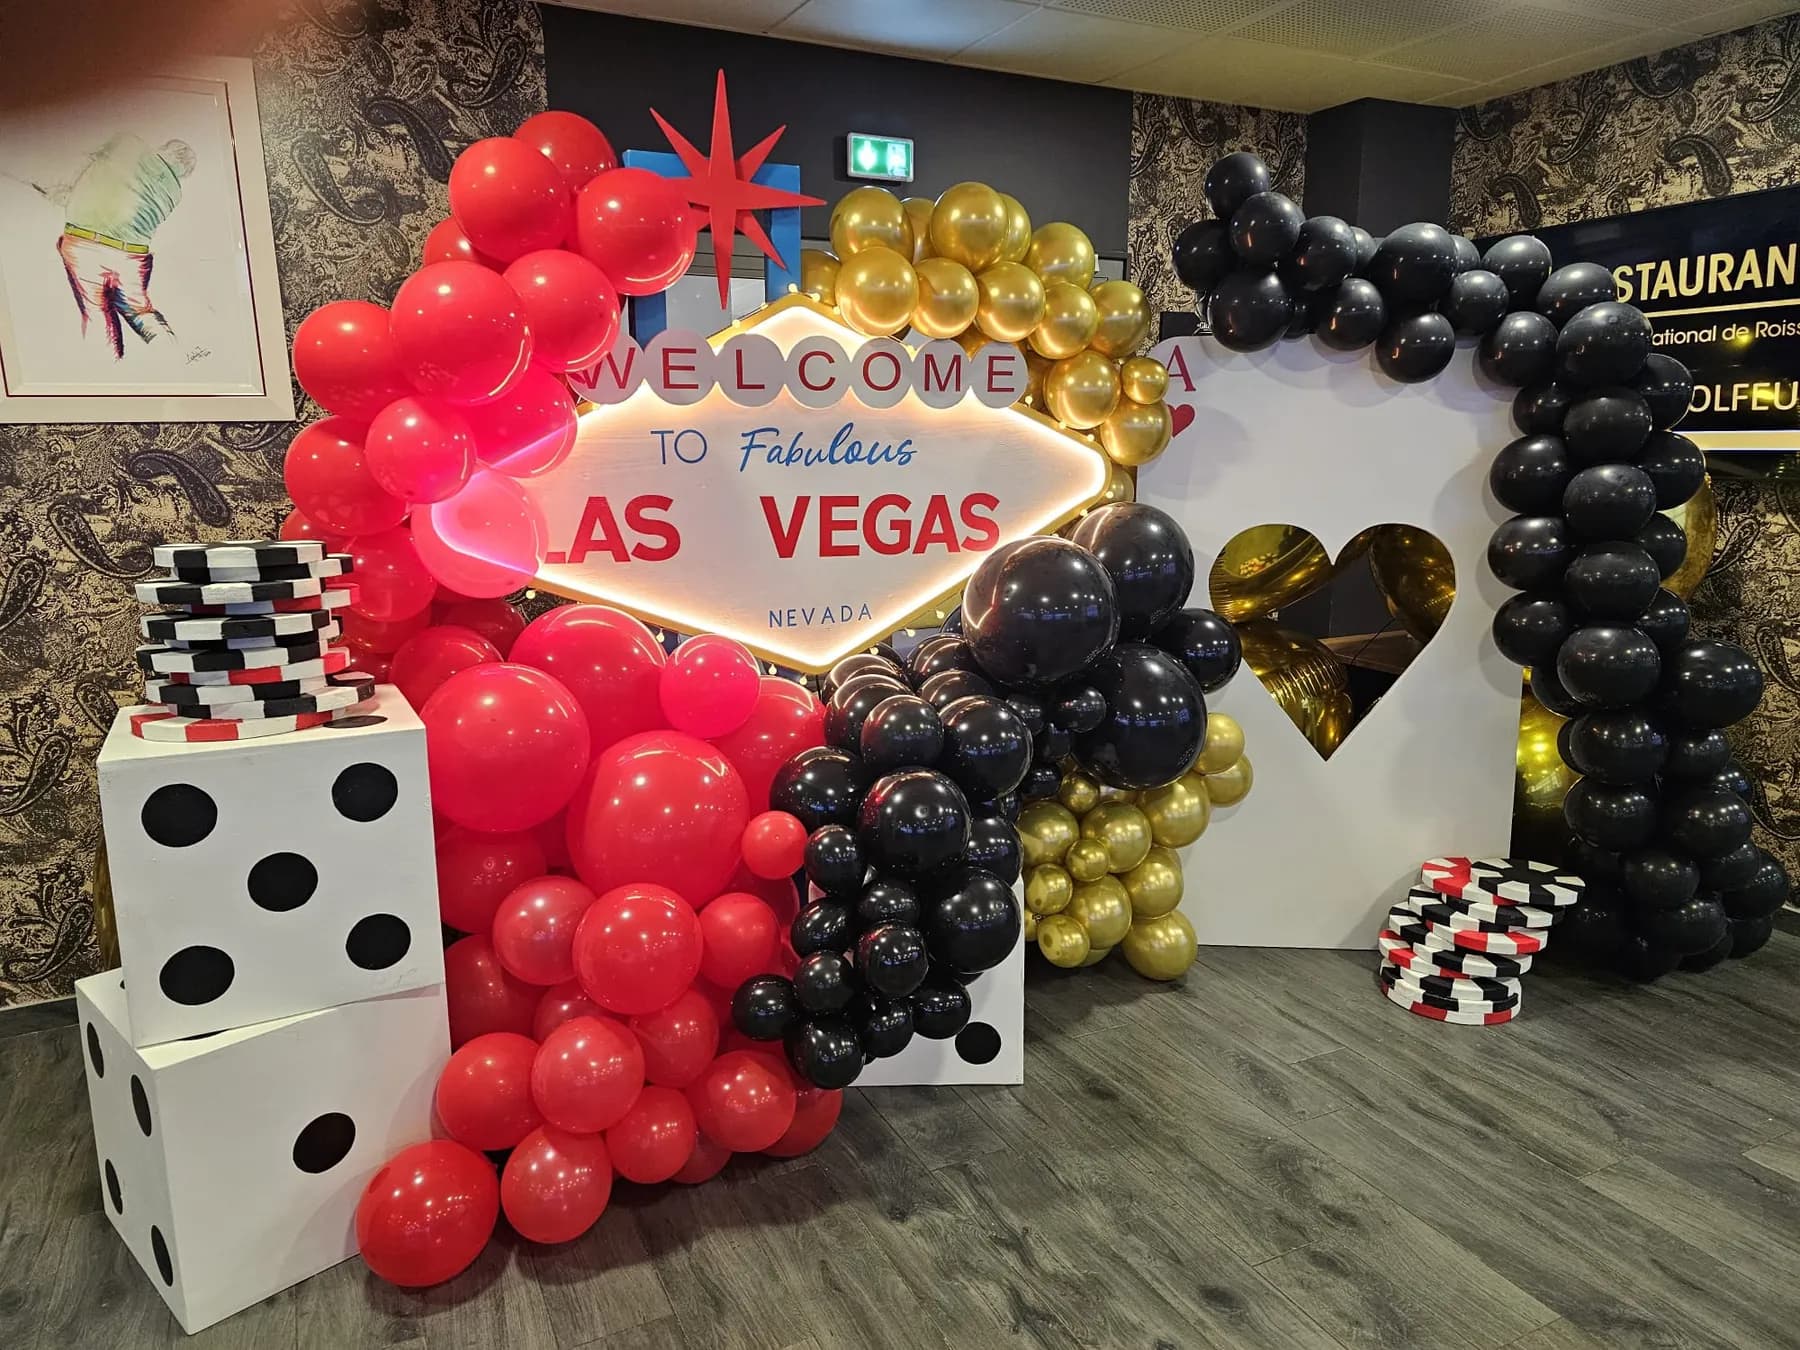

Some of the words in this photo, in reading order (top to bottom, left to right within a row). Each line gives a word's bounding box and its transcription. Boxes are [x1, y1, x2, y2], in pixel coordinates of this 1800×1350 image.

[1722, 323, 1750, 341] de
[580, 347, 1016, 392] WELCOME
[1167, 345, 1196, 392] A
[650, 429, 708, 465] TO
[739, 422, 918, 472] Fabulous
[544, 494, 681, 564] AS
[759, 492, 1001, 559] VEGAS
[768, 602, 873, 628] NEVADA
